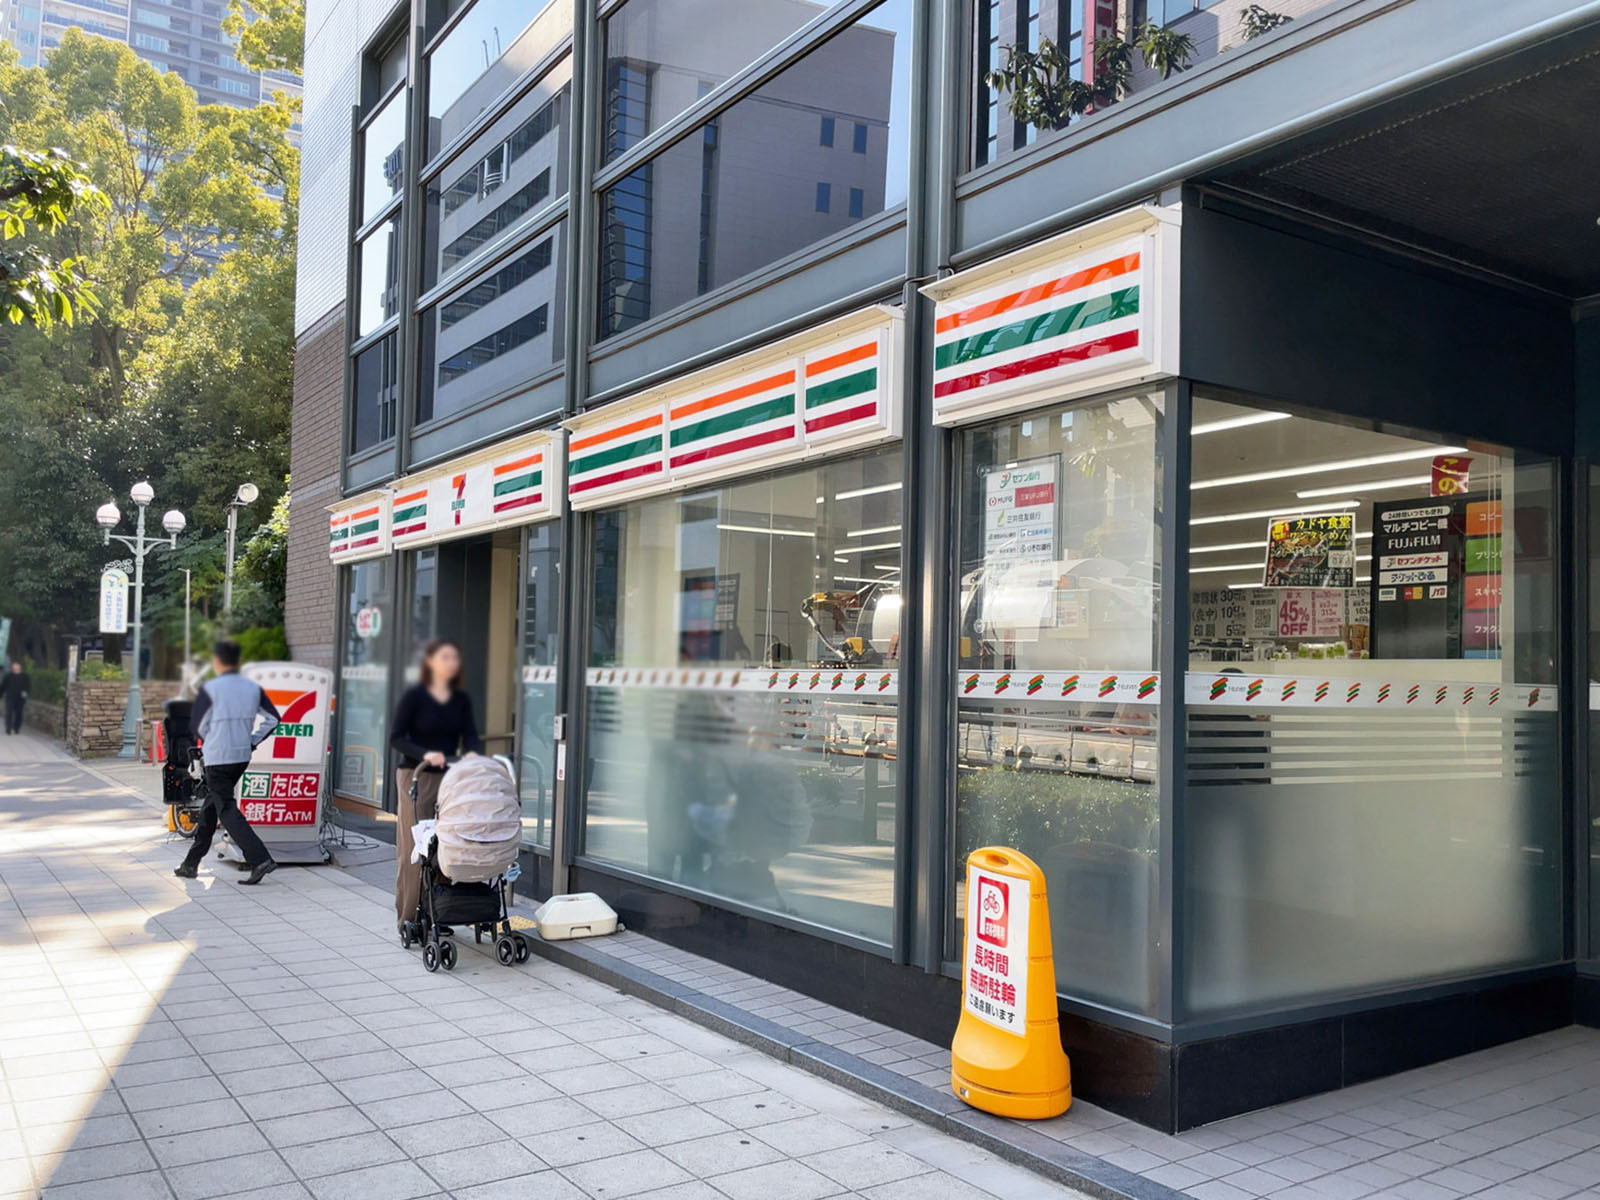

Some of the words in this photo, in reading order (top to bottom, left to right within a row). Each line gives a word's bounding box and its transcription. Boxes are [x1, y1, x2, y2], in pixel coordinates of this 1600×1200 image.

[1438, 458, 1458, 496] この
[1296, 516, 1351, 530] カドヤ食堂
[1383, 518, 1448, 533] マルチコピー機
[1280, 600, 1310, 622] 45%
[1280, 623, 1308, 636] OFF
[243, 774, 270, 797] 酒
[271, 775, 317, 798] たばこ
[975, 944, 1009, 977] 長時間
[970, 968, 1016, 1007] 無断駐輪
